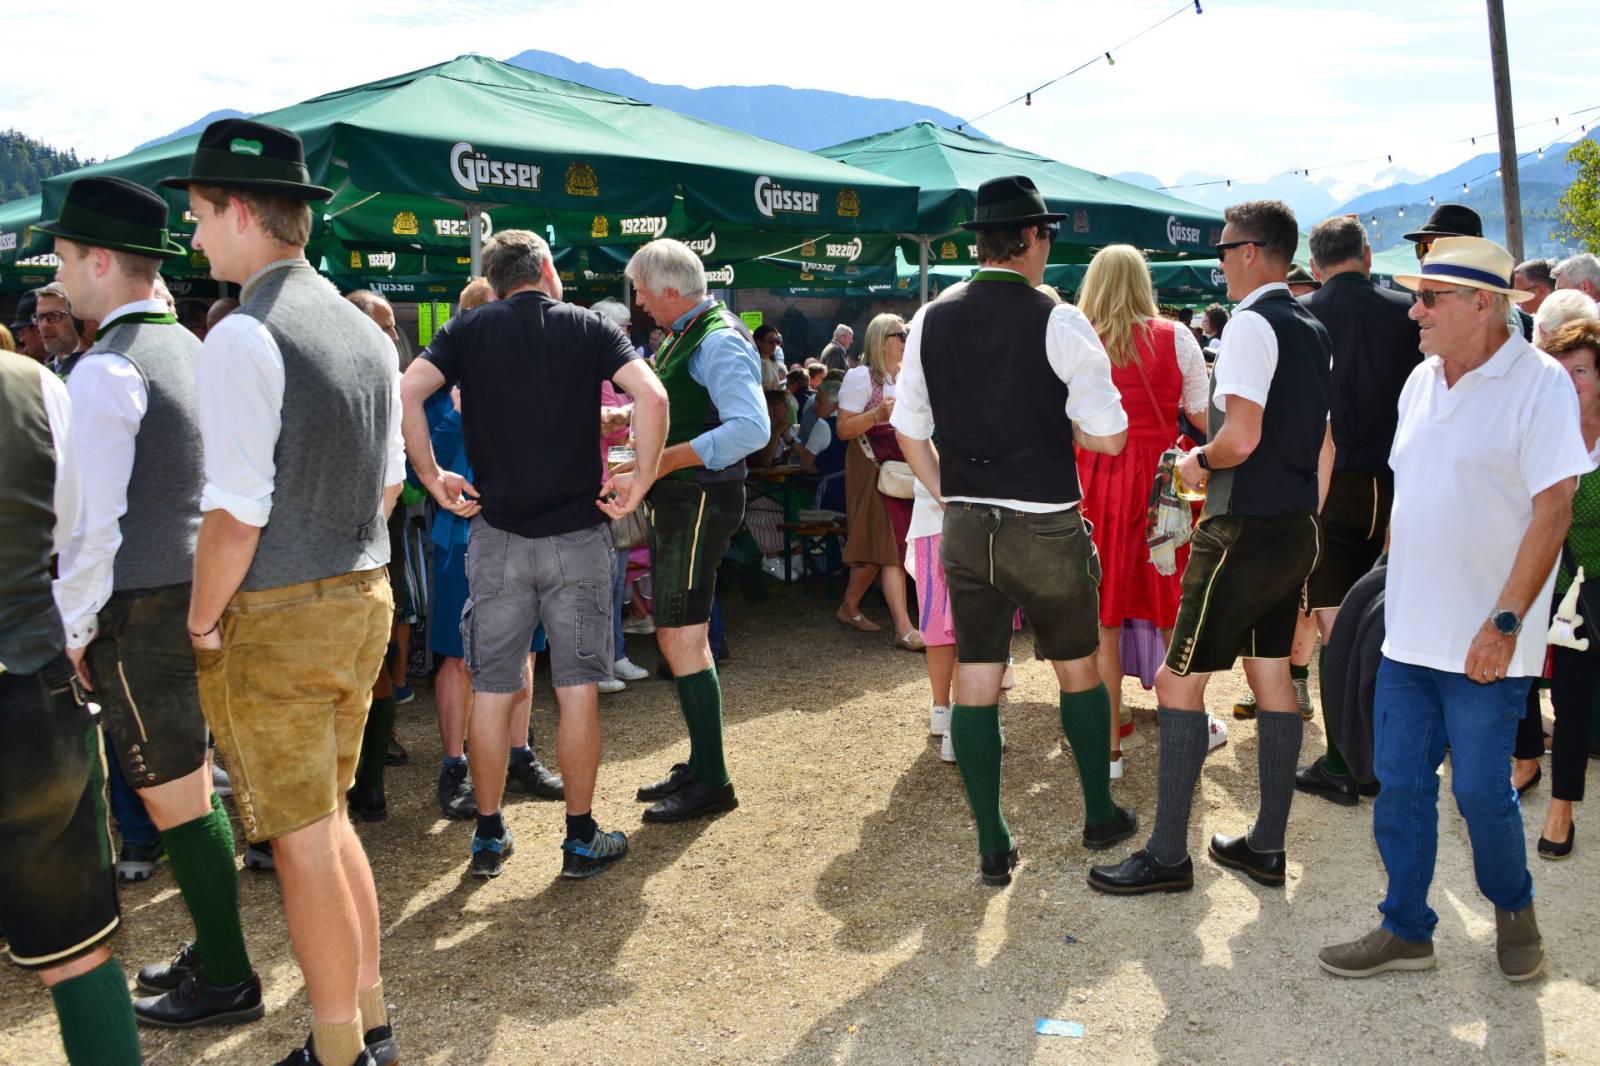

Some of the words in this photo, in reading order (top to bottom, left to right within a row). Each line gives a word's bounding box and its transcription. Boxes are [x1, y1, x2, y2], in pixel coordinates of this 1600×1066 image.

[450, 142, 541, 192] Gösser
[754, 175, 820, 217] Gösser
[1166, 215, 1201, 246] Gösser
